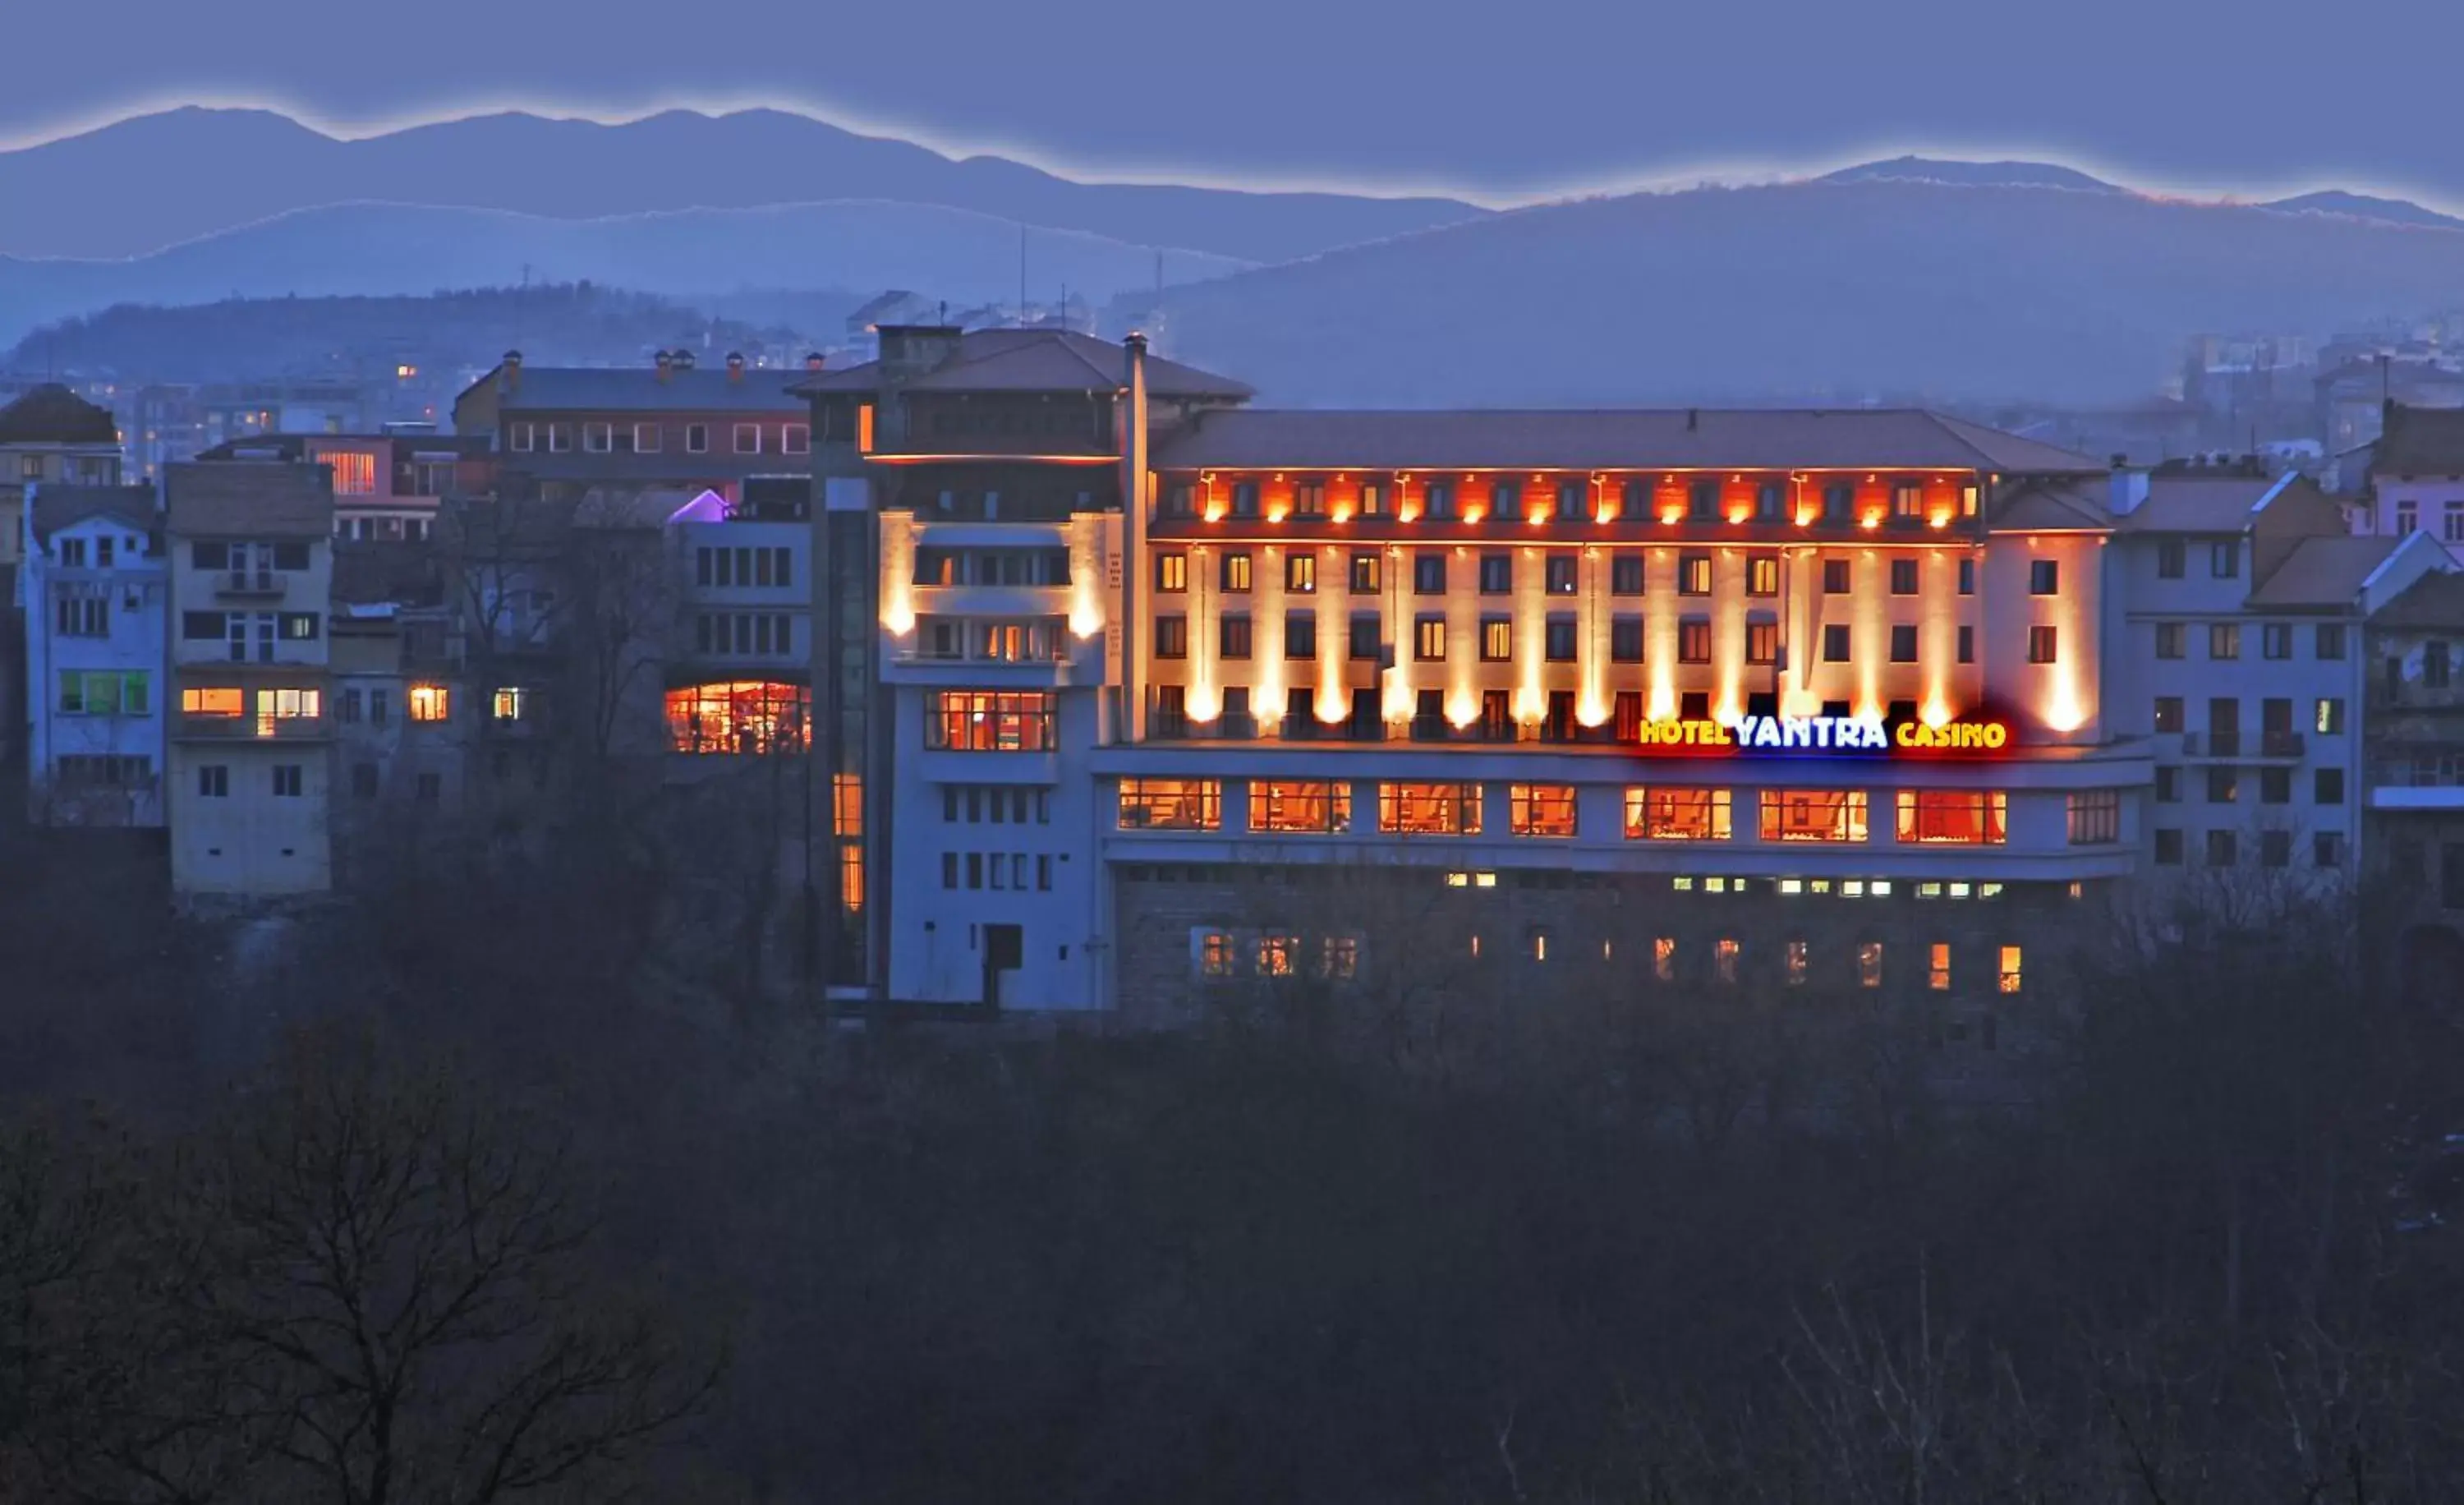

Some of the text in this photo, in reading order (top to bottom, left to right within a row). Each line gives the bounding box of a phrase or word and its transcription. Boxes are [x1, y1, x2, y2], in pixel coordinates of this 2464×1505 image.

[1639, 716, 2006, 748] HOTEL YANTRA CASINO
